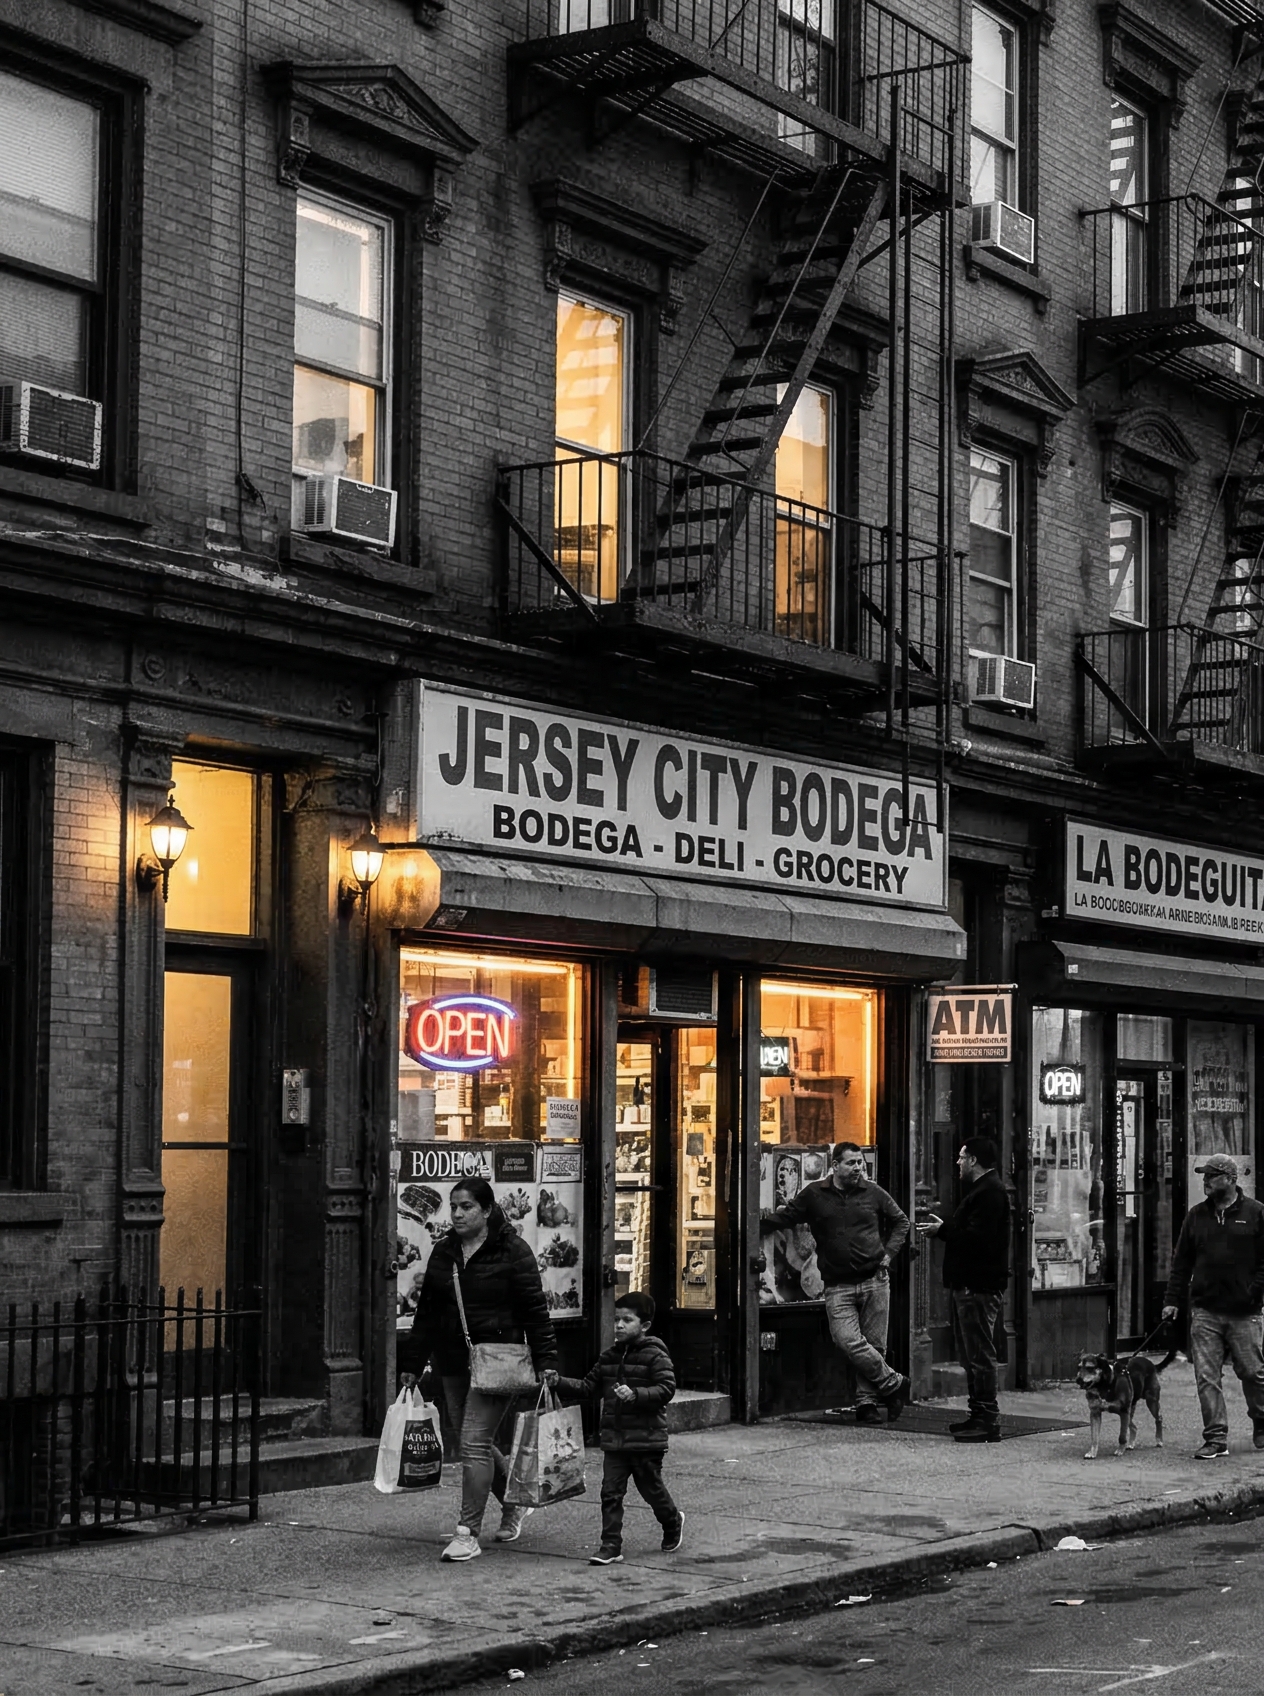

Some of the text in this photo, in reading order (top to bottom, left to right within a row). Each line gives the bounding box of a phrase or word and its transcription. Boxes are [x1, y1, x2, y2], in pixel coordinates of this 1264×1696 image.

[438, 706, 933, 861] JERSEY CITY BODEGA
[492, 804, 643, 859] BODEGA
[675, 833, 744, 873] DELI
[773, 847, 909, 895] GROCERY
[1075, 834, 1114, 888] LA
[417, 1009, 510, 1058] OPEN
[931, 999, 1008, 1035] ATM
[1045, 1071, 1082, 1096] OPEN
